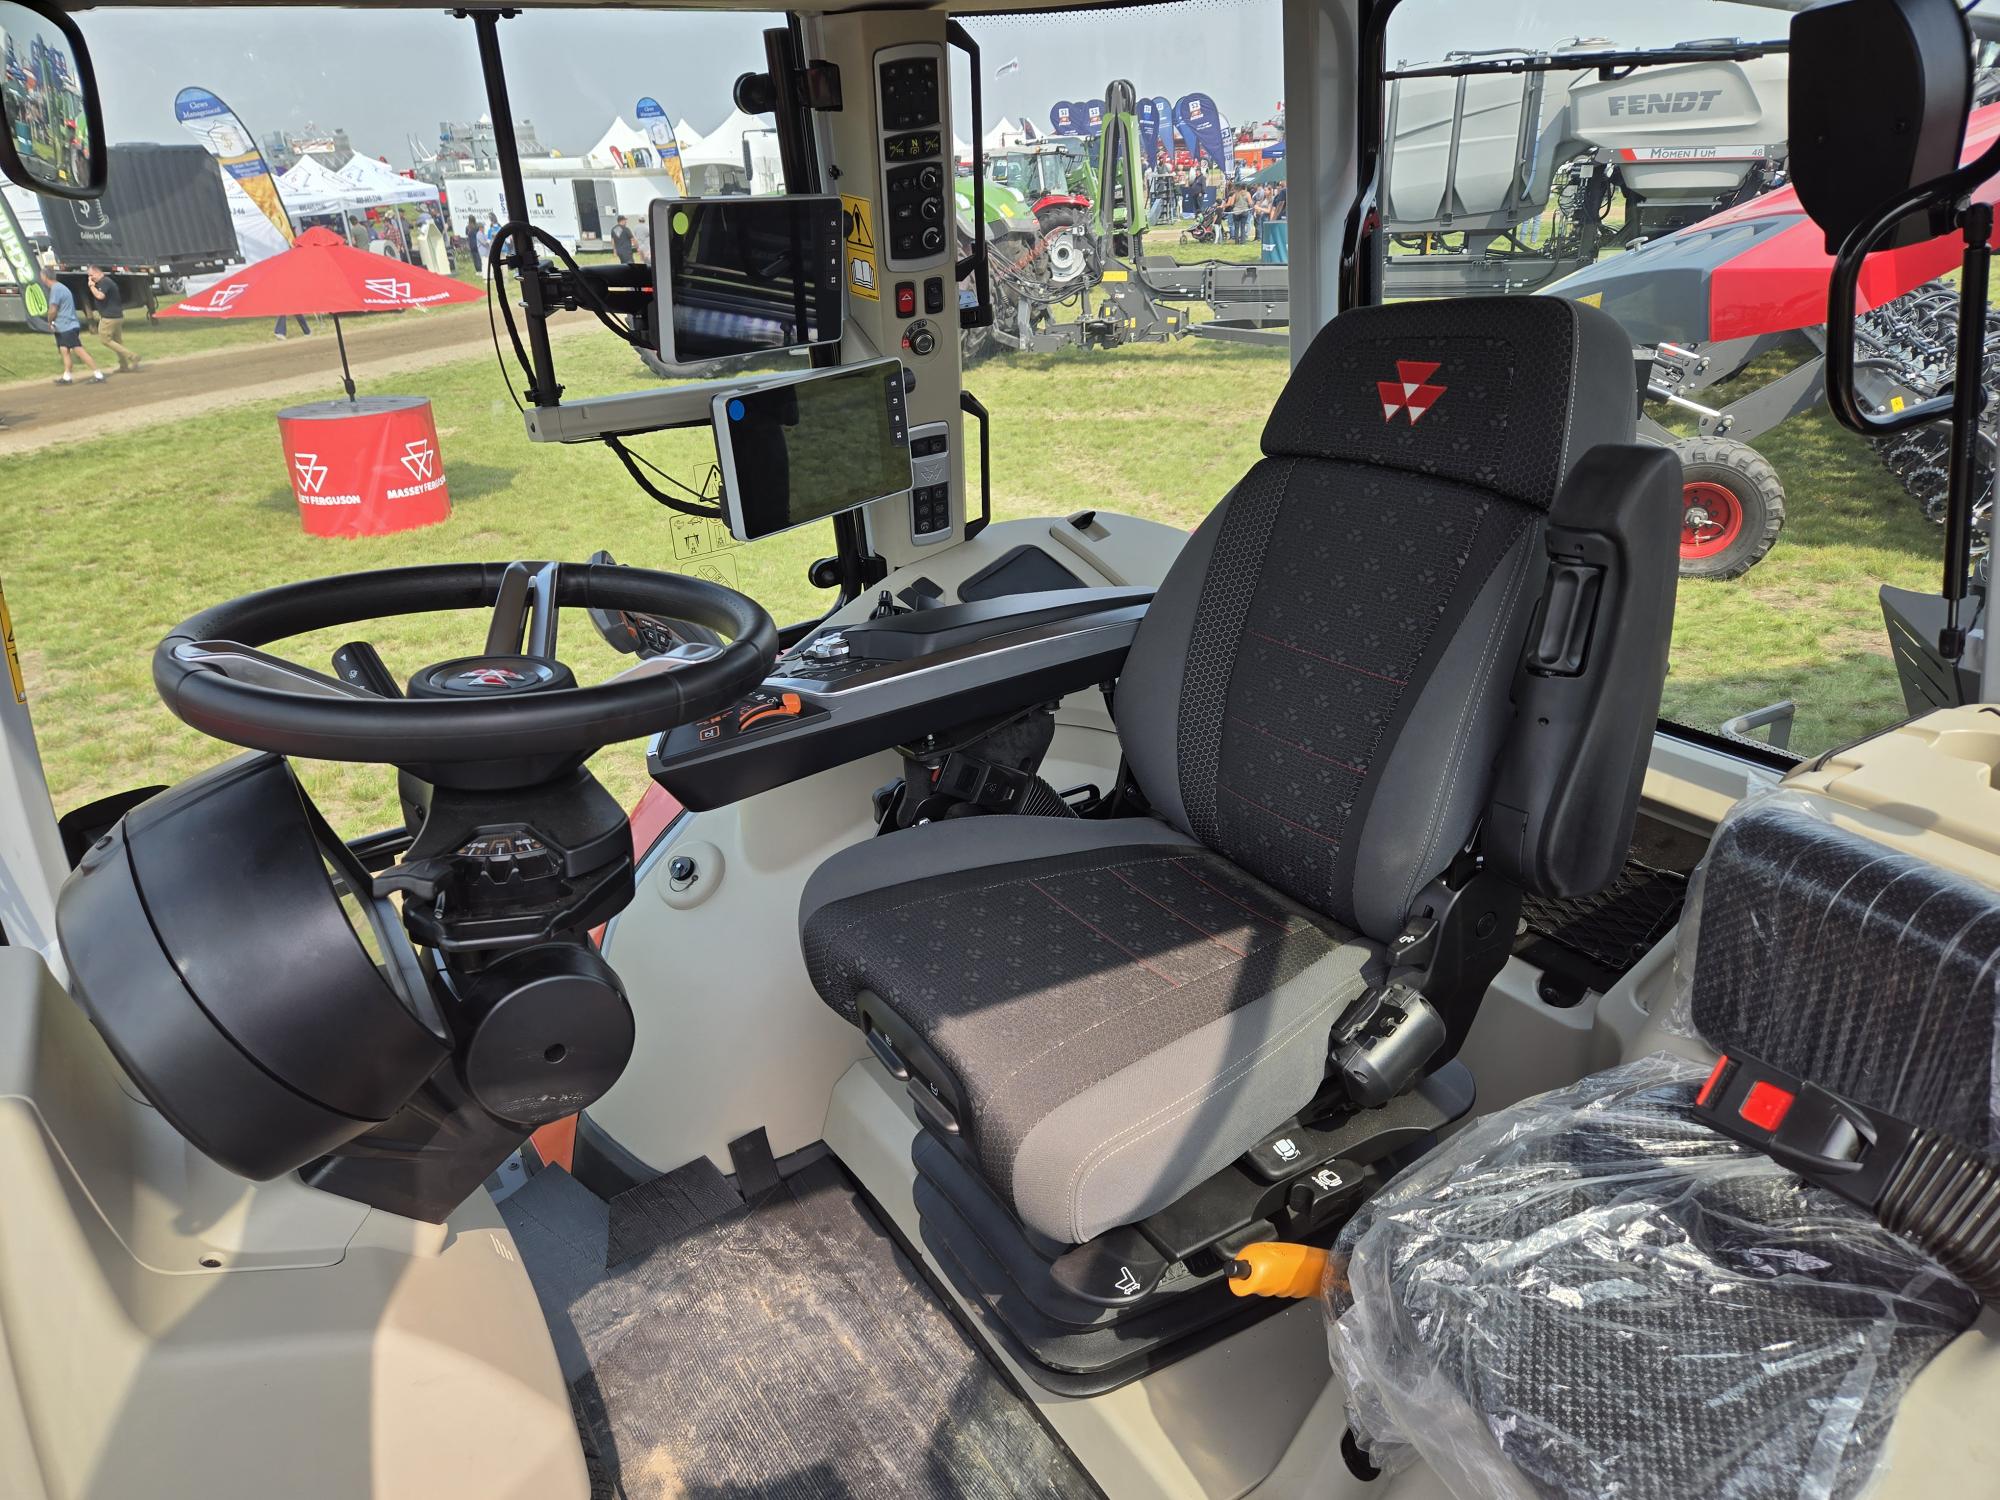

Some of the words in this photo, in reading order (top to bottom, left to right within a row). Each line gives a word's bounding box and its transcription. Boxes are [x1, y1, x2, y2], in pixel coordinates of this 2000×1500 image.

[1608, 90, 1723, 116] FENDT
[1751, 148, 1763, 157] 48
[387, 483, 425, 500] MASSEY
[311, 495, 361, 506] FERGUSON
